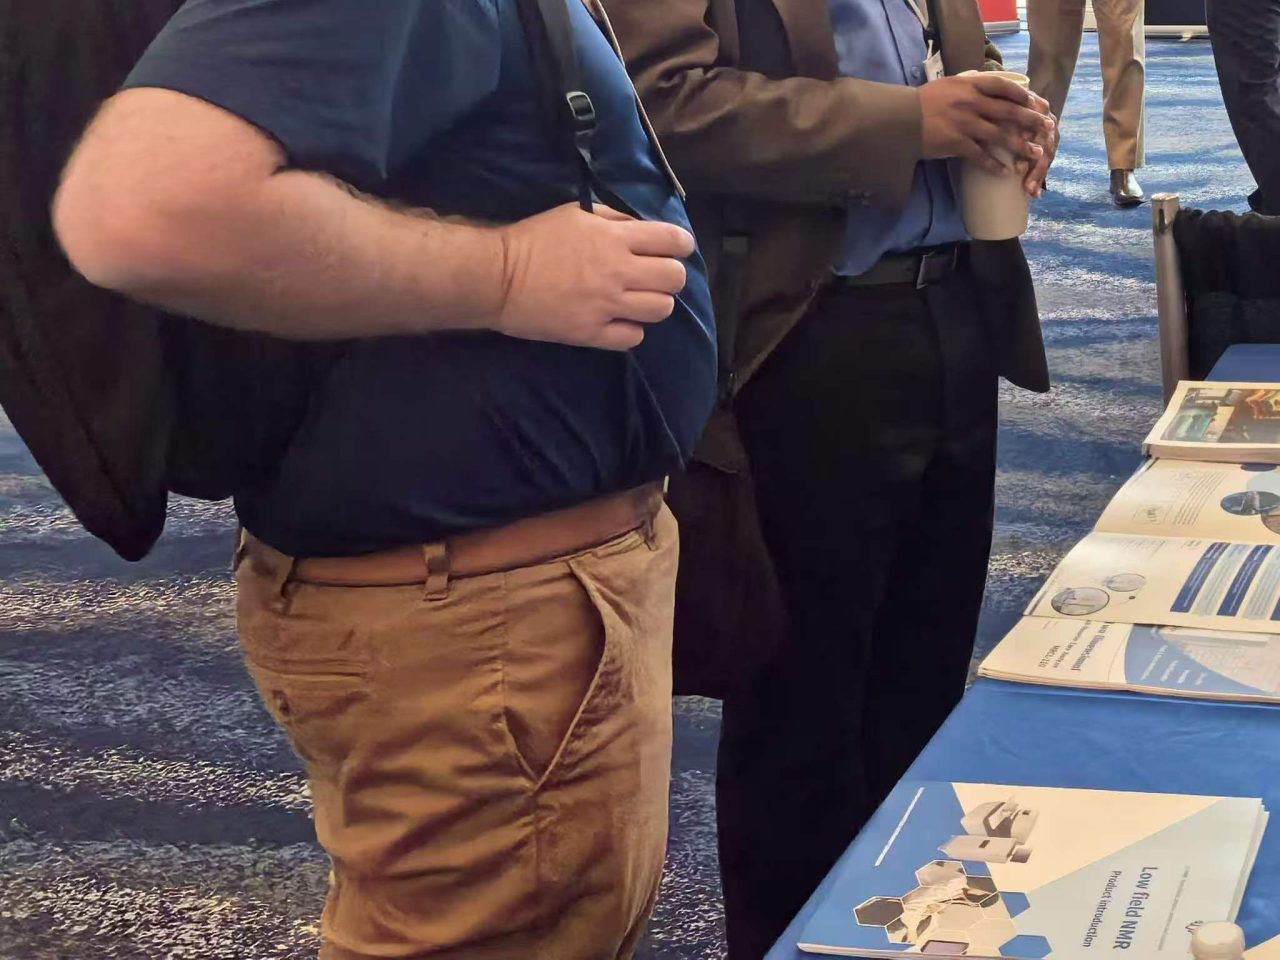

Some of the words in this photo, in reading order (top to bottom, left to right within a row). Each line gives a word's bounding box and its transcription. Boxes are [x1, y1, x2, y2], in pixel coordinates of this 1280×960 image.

[1099, 870, 1122, 900] Product
[1135, 866, 1160, 890] Low
[1124, 892, 1151, 918] field
[1082, 899, 1111, 948] introduction
[1112, 920, 1139, 950] NMR
